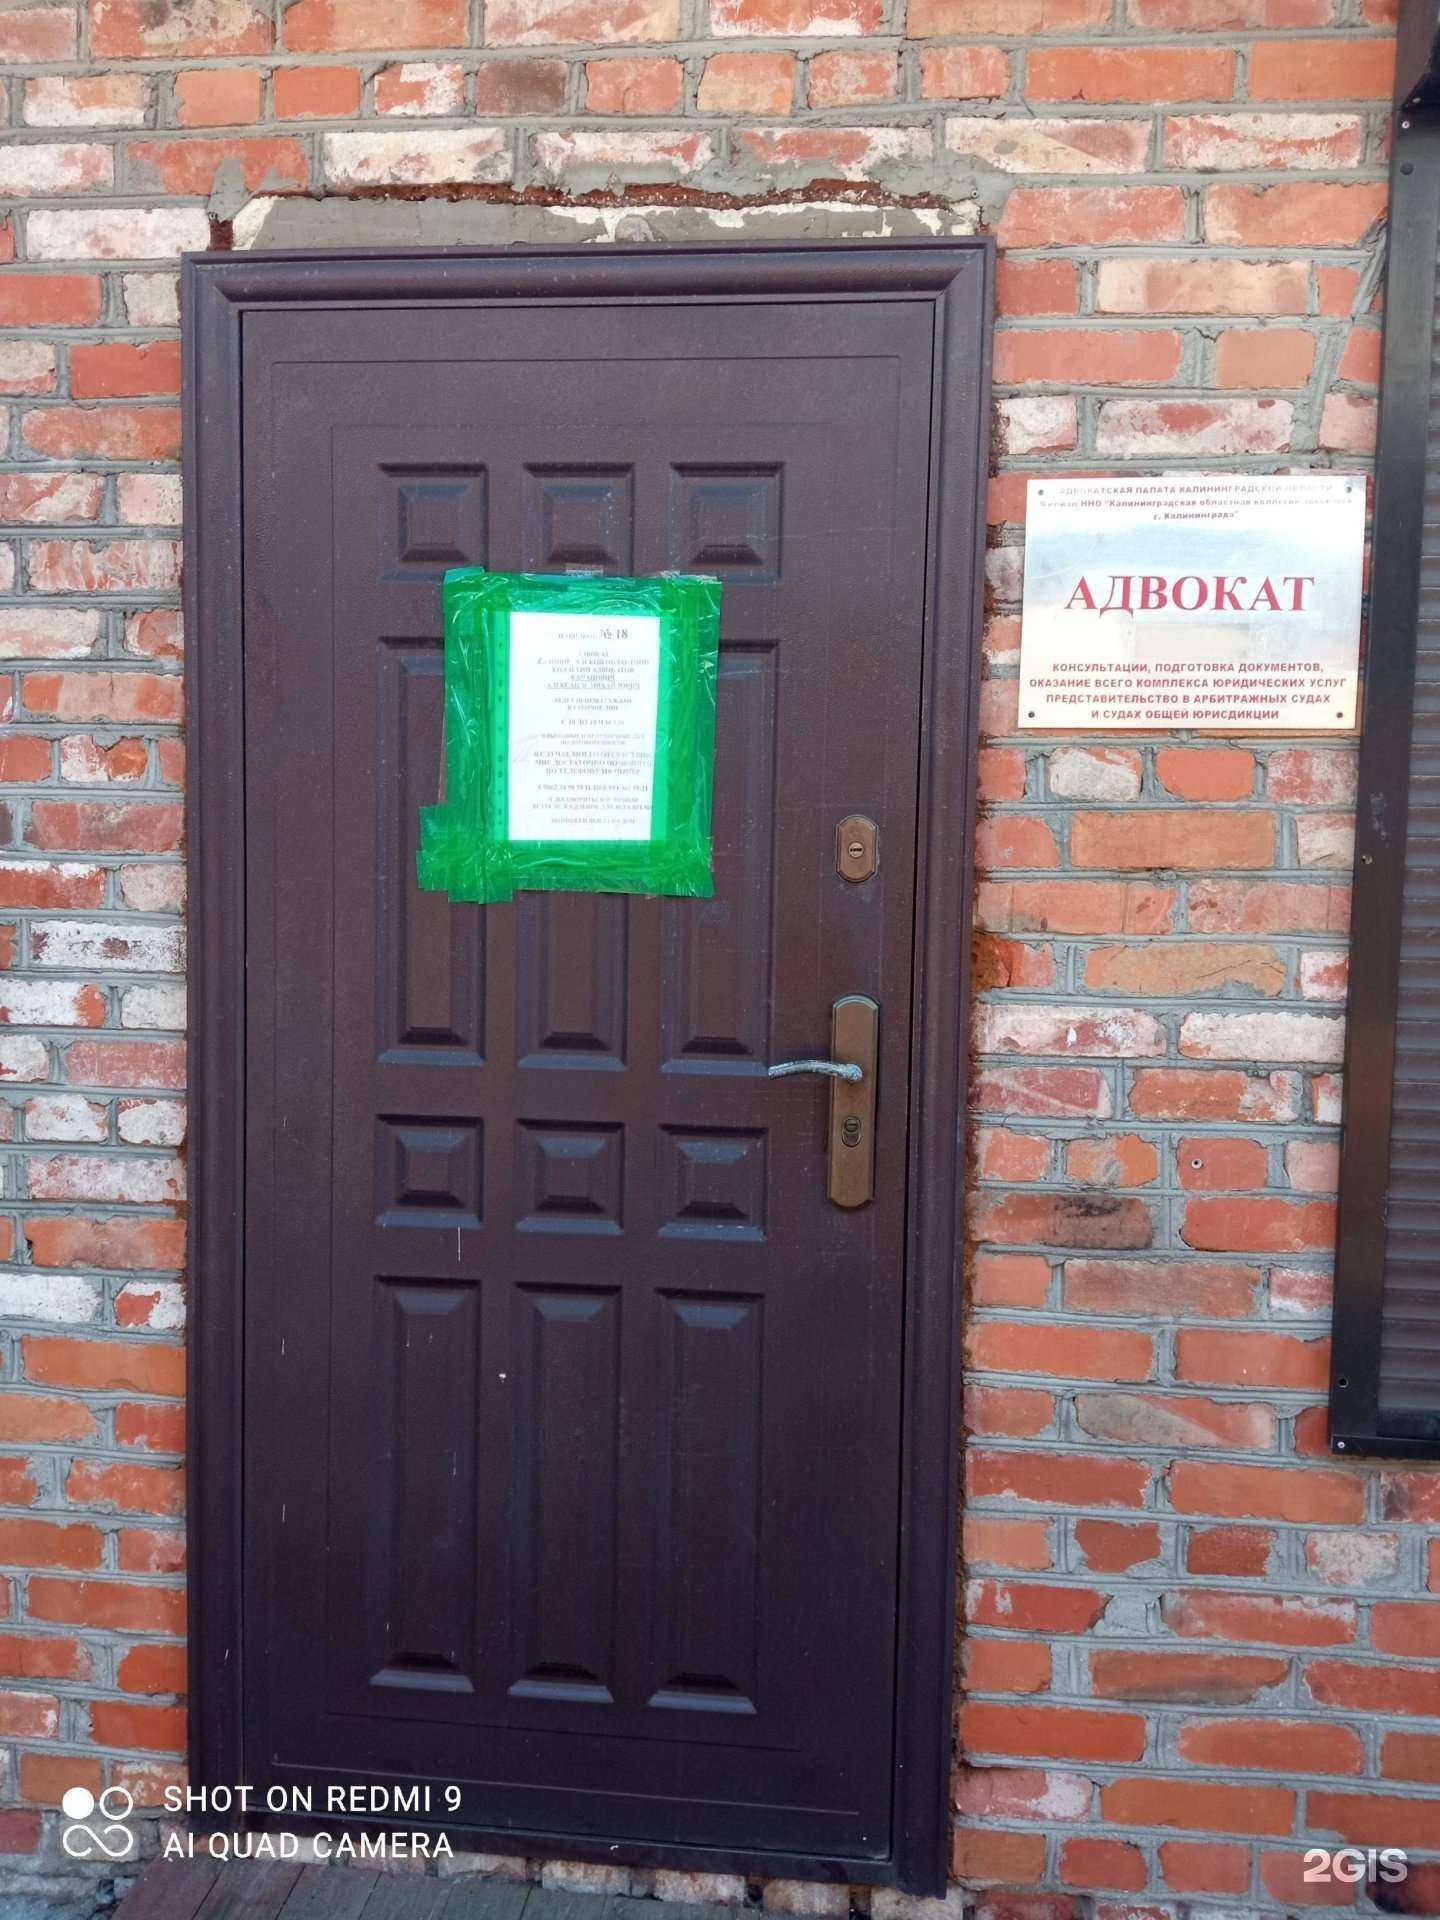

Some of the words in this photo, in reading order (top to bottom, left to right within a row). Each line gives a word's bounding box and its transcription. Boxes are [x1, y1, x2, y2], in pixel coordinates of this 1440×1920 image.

[1136, 486, 1176, 495] ПАЛАТА
[1080, 499, 1102, 507] ННО
[1105, 498, 1198, 508] "Калининградская
[1064, 575, 1315, 618] АДВОКАТ
[616, 628, 629, 640] 18
[1052, 663, 1152, 674] КОНСУЛЬТАЦИИ,
[1155, 663, 1235, 674] ПОДГОТОВКА
[1238, 663, 1324, 673] ДОКУМЕНТОВ,
[1029, 679, 1091, 688] ОКАЗАНИЕ
[1094, 679, 1133, 688] ВСЕГО
[1136, 679, 1209, 688] КОМПЛЕКСА
[1212, 678, 1305, 689] ЮРИДИЧЕСКИХ
[1309, 678, 1347, 688] УСЛУГ
[1046, 694, 1178, 705] ПРЕДСТАВИТЕЛЬСТВО
[1182, 695, 1191, 703] В
[1194, 694, 1287, 704] АРБИТРАЖНЫХ
[1291, 694, 1331, 705] СУДАХ
[1091, 710, 1099, 719] И
[1103, 710, 1142, 720] СУДАХ
[1145, 709, 1189, 720] ОБЩЕЙ
[1192, 710, 1280, 721] ЮРИСДИКЦИИ
